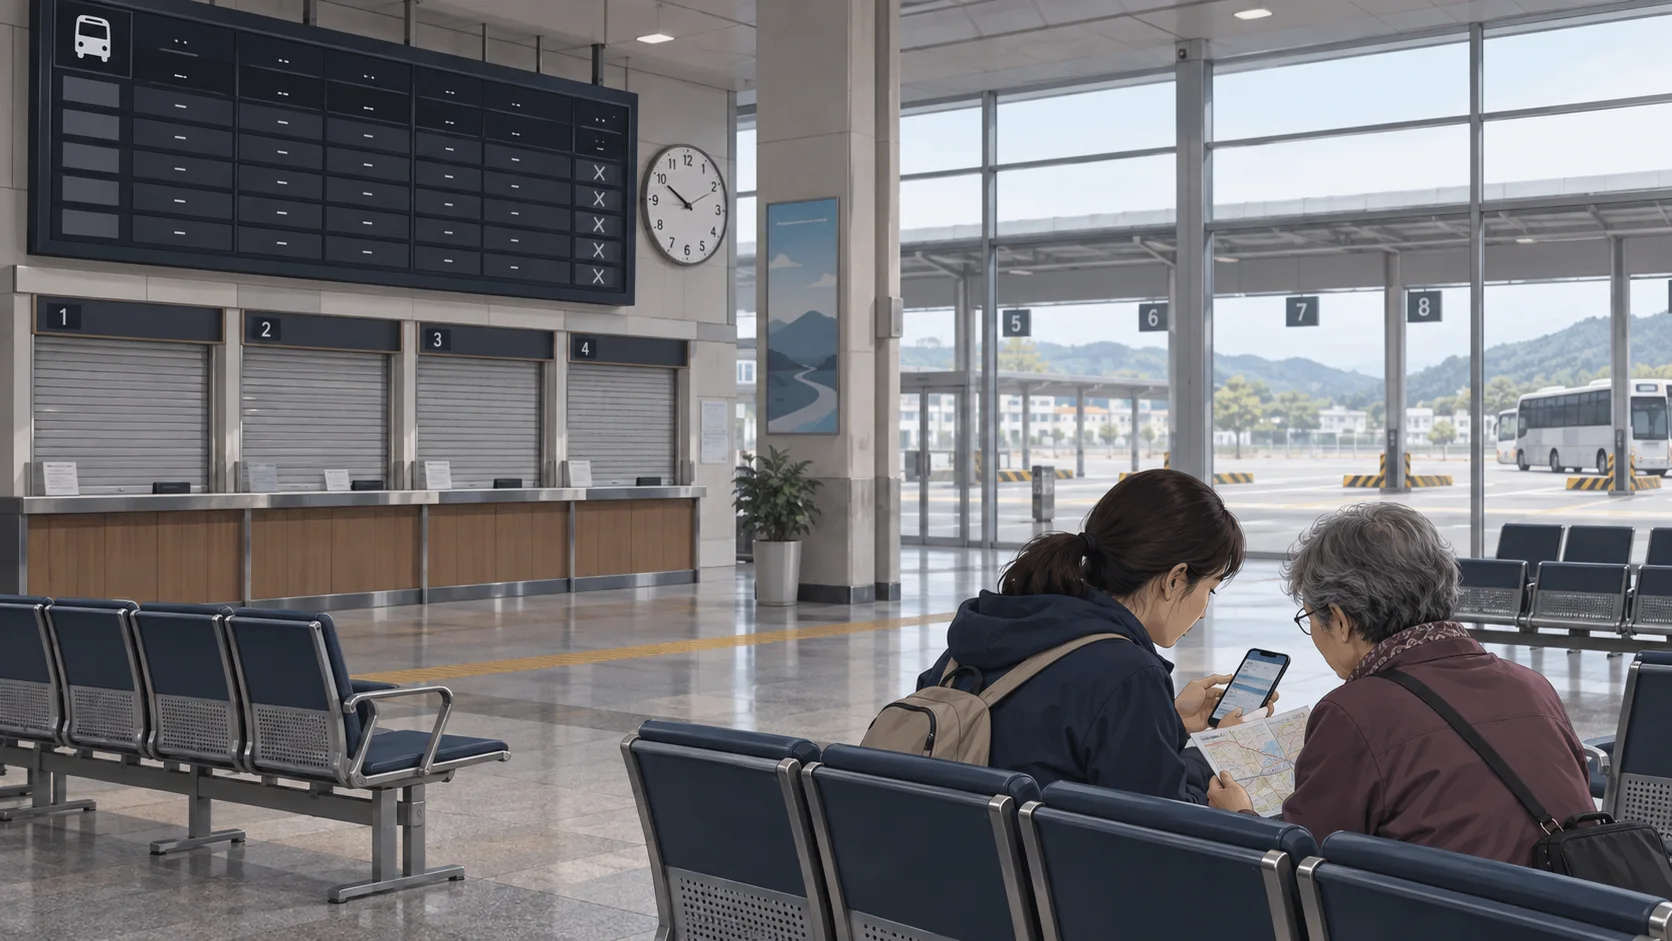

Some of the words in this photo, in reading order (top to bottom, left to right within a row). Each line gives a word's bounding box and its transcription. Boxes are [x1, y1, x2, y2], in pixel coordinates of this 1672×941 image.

[668, 158, 676, 170] 11
[683, 154, 693, 167] 12
[701, 163, 706, 174] 1
[656, 173, 667, 184] 10
[711, 181, 718, 193] 2
[652, 194, 659, 206] 9
[715, 204, 721, 216] 3
[656, 219, 663, 231] 8
[710, 227, 716, 238] 4
[669, 237, 675, 249] 7
[699, 241, 706, 252] 5
[684, 244, 691, 256] 6
[1296, 302, 1308, 321] 7
[1418, 298, 1430, 317] 8
[59, 307, 67, 326] 1
[1147, 308, 1159, 328] 6
[1011, 314, 1022, 333] 5
[261, 321, 271, 339] 2
[433, 332, 442, 349] 3
[581, 341, 590, 356] 4
